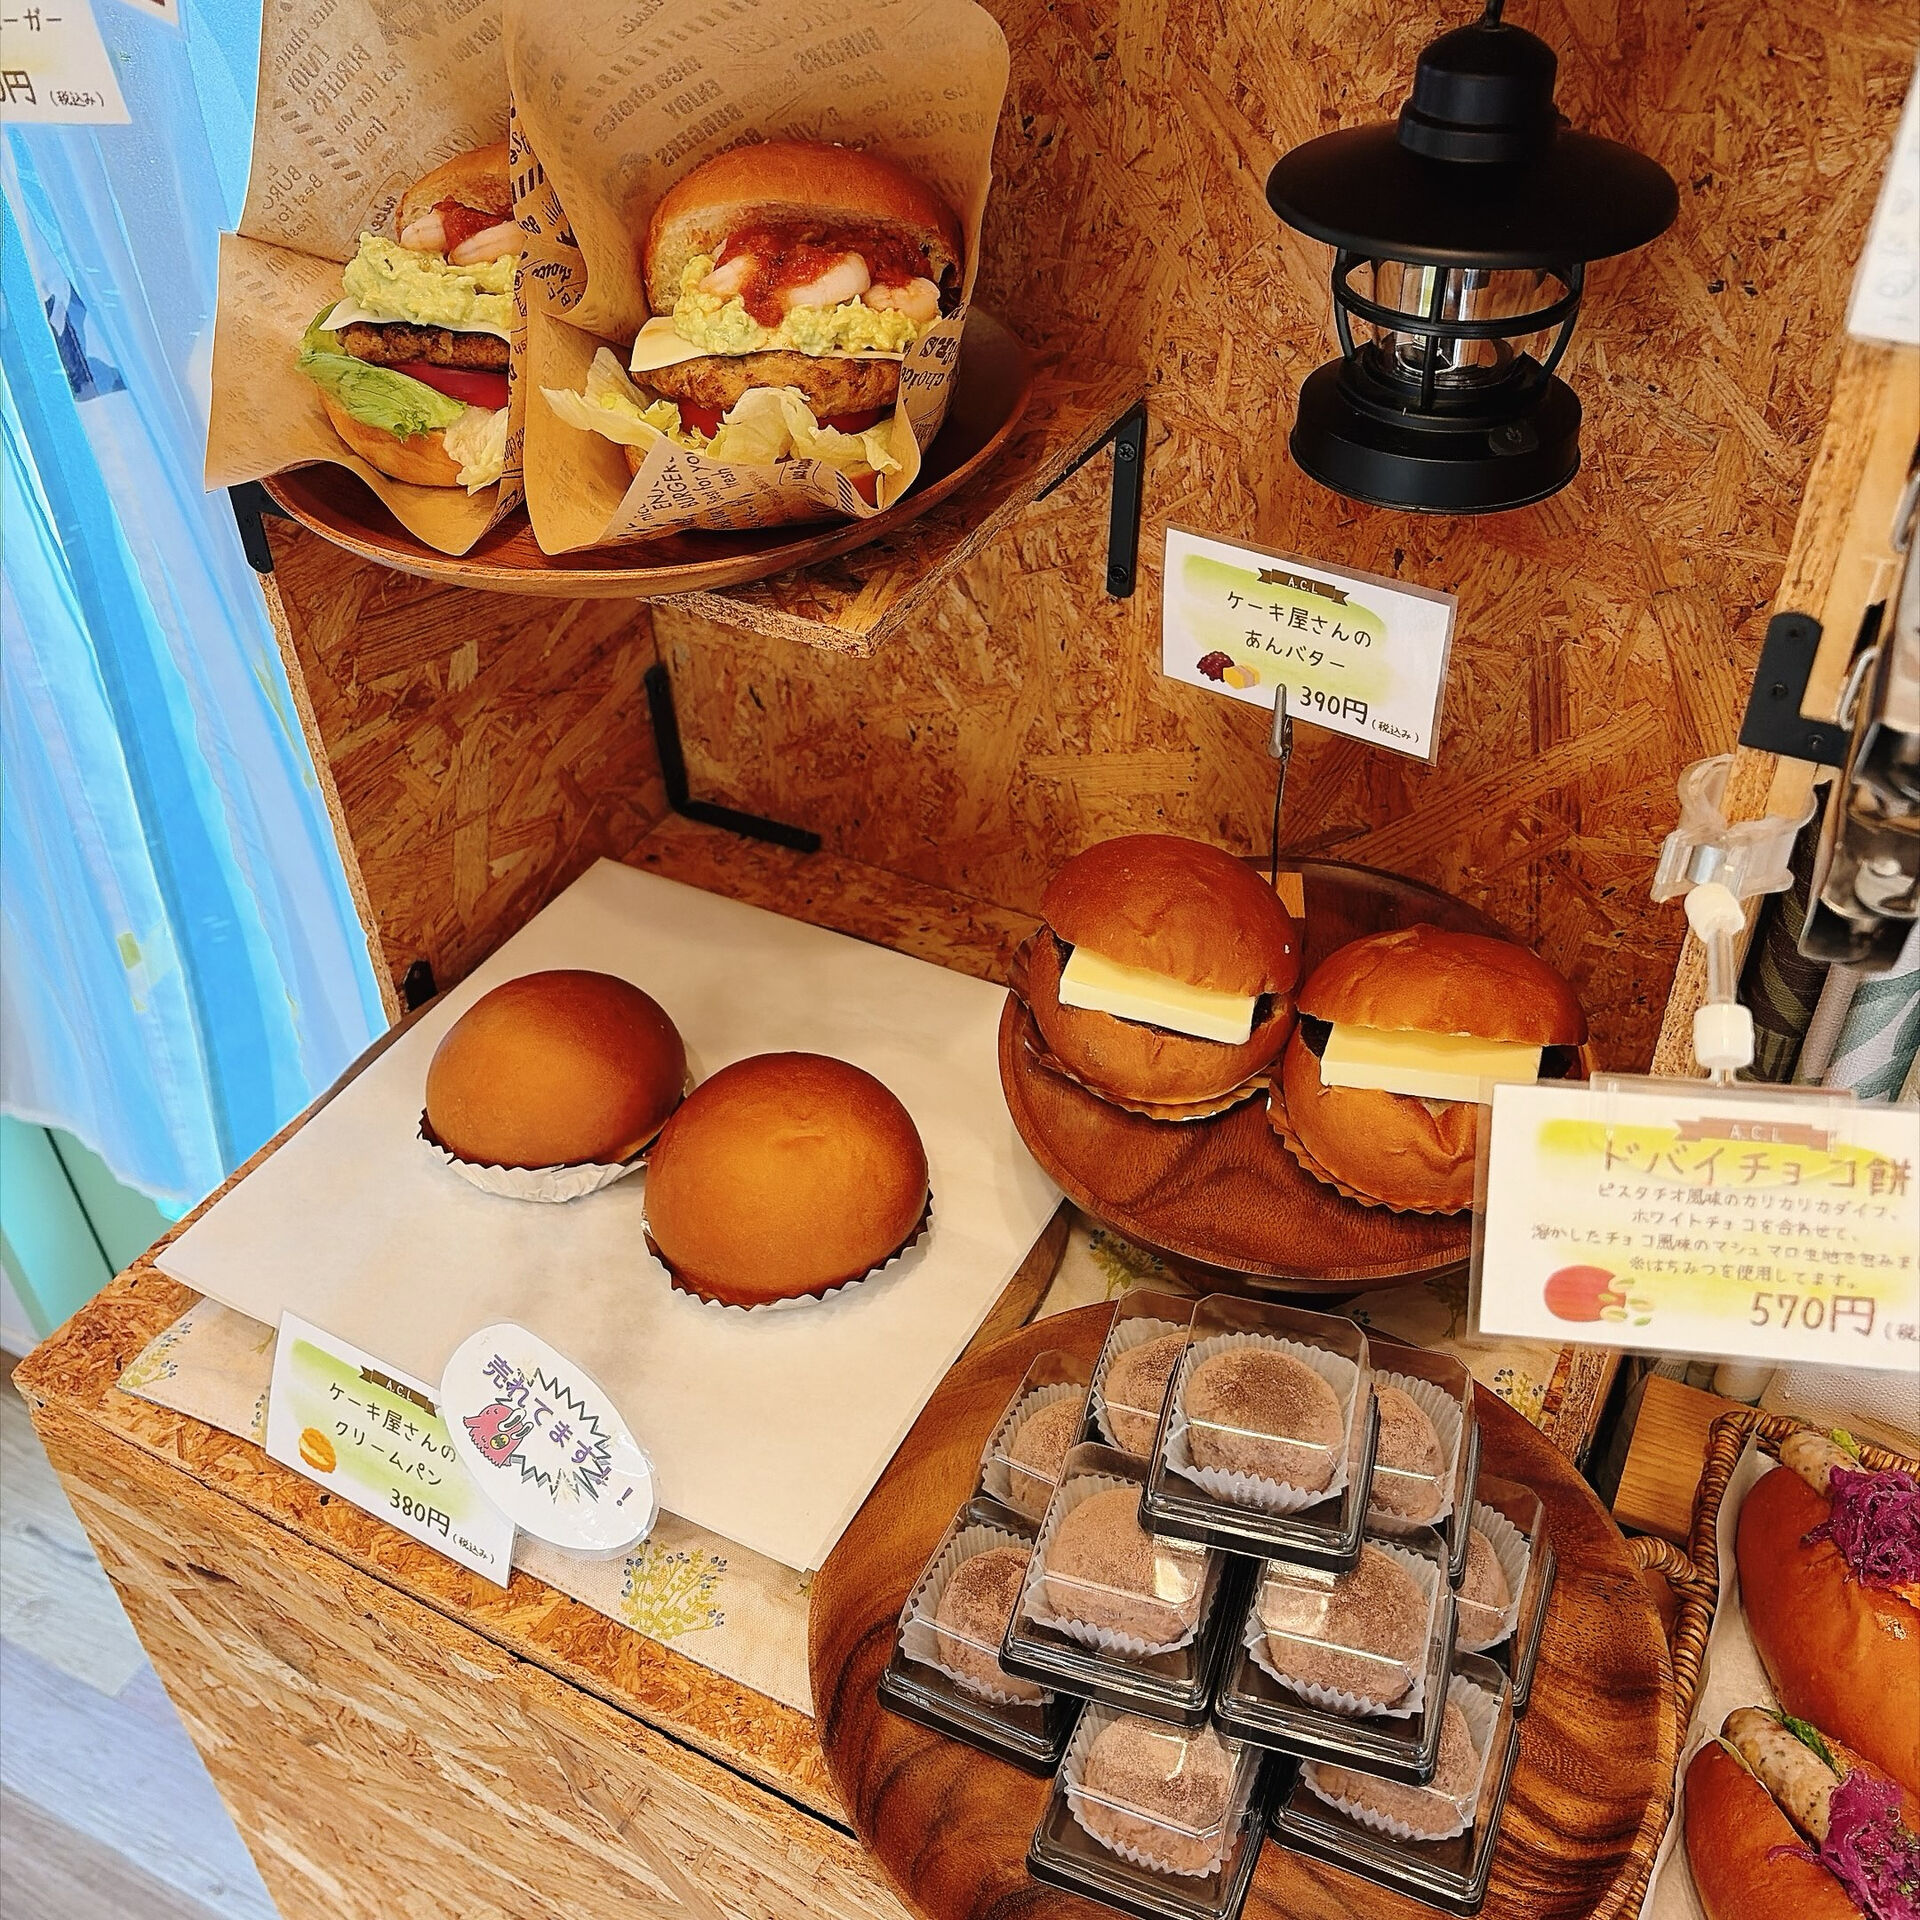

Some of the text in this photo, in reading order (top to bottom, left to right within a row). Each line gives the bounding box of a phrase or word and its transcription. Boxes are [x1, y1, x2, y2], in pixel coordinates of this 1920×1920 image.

[0, 8, 62, 31] ーガー
[1227, 591, 1372, 648] ケーキ屋さんの
[1245, 630, 1346, 668] あんバター
[1300, 686, 1368, 725] 390円
[1605, 1140, 1912, 1196] ドバイチョコ餅
[1751, 1292, 1876, 1336] 570円
[329, 1382, 456, 1463] ケーキ屋さんの
[335, 1421, 442, 1486] クリームパン
[389, 1488, 451, 1537] 380円
